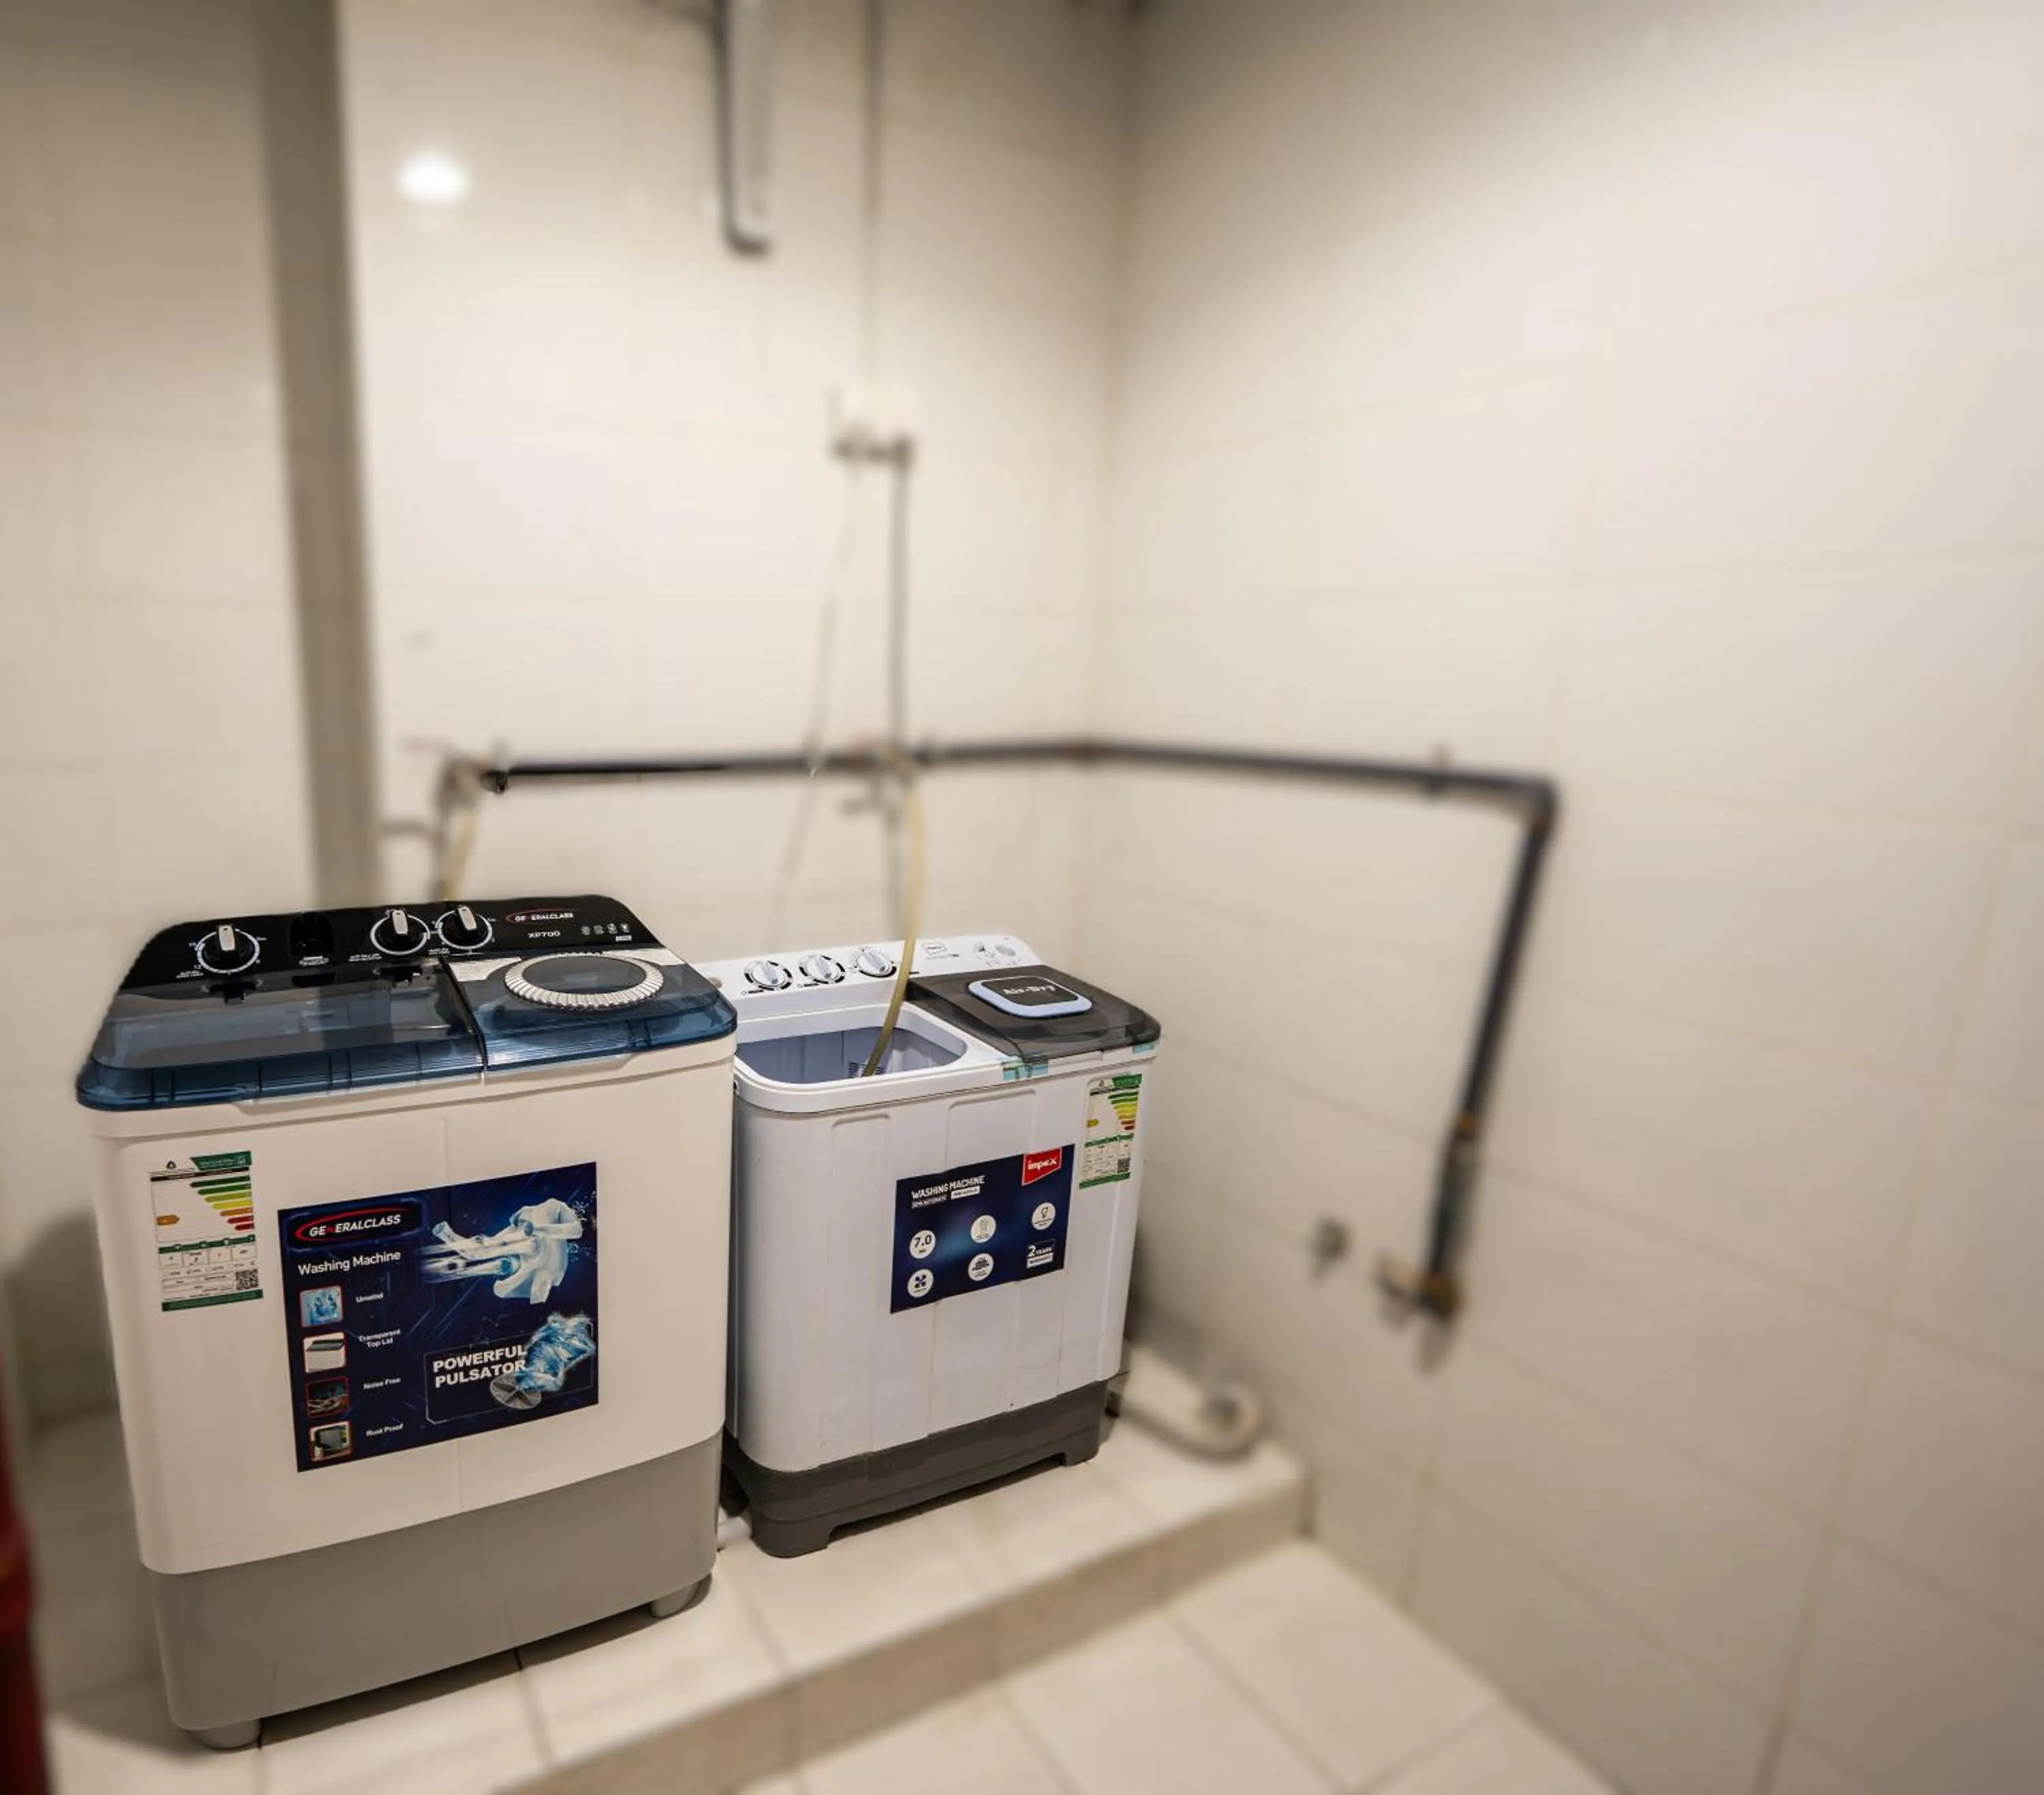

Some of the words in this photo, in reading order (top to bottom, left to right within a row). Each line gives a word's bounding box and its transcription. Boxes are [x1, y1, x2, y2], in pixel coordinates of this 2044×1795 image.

[1027, 1156, 1057, 1171] impex
[911, 1182, 949, 1199] WASHING
[949, 1174, 986, 1191] MACHINE
[914, 1234, 932, 1248] 7.0
[298, 1259, 350, 1276] Washing
[352, 1251, 402, 1268] Machine
[433, 1344, 528, 1373] POWERFUL
[385, 1377, 401, 1385] Free
[435, 1359, 527, 1388] PULSATOR
